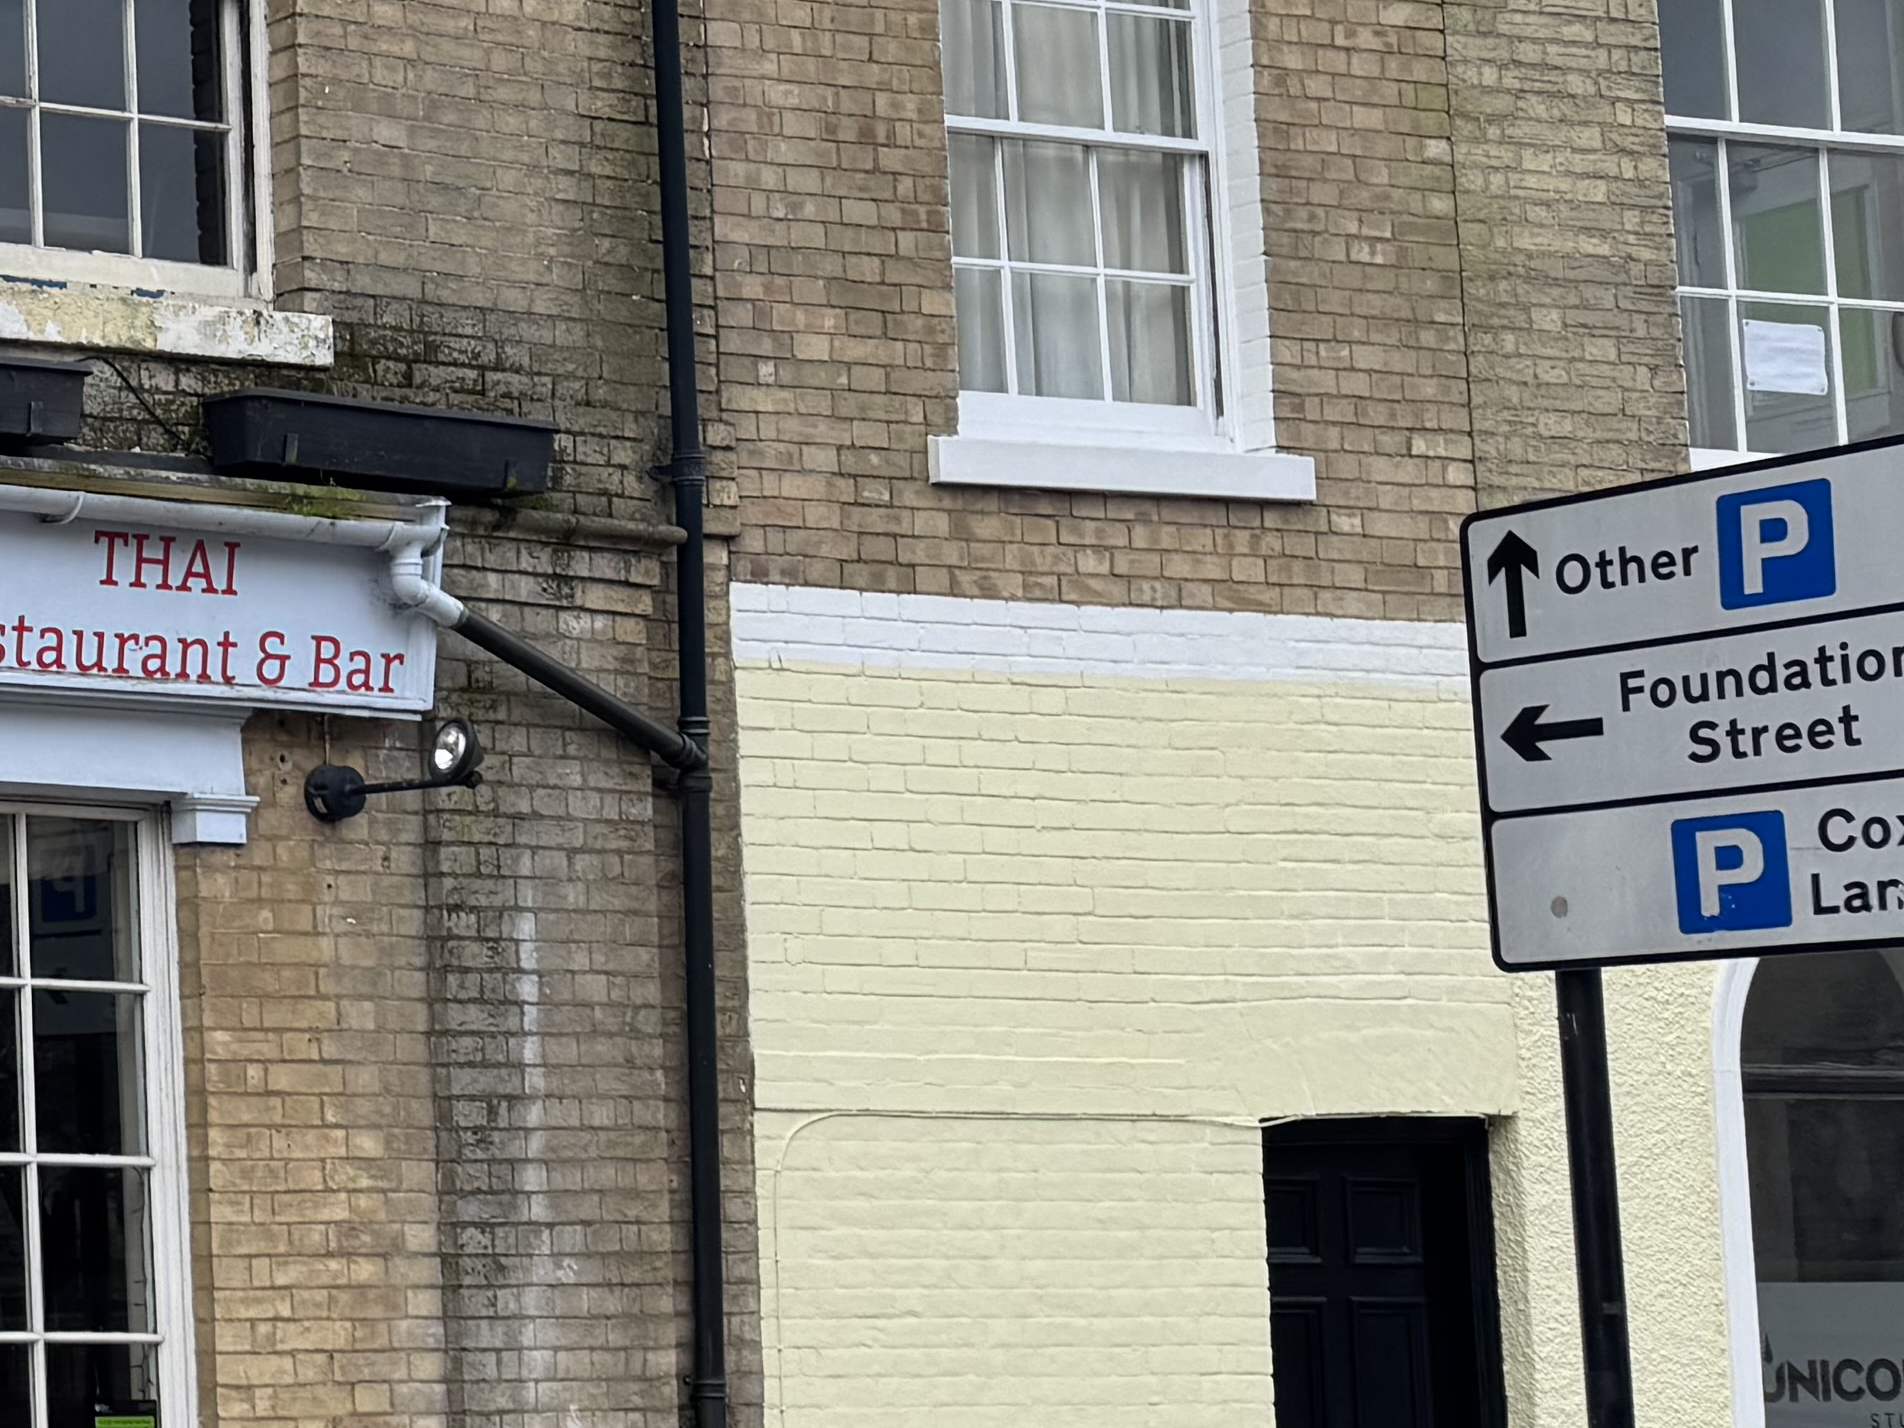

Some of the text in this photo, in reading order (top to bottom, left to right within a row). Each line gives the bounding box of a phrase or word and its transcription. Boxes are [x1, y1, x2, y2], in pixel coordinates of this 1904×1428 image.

[94, 529, 241, 596] THAI
[1555, 499, 1810, 596] Other P
[255, 631, 290, 686] &
[309, 635, 405, 693] Bar
[1687, 704, 1862, 764] Street
[1818, 808, 1904, 852] Co
[1695, 828, 1765, 918] P
[1763, 1358, 1904, 1403] UNICO
